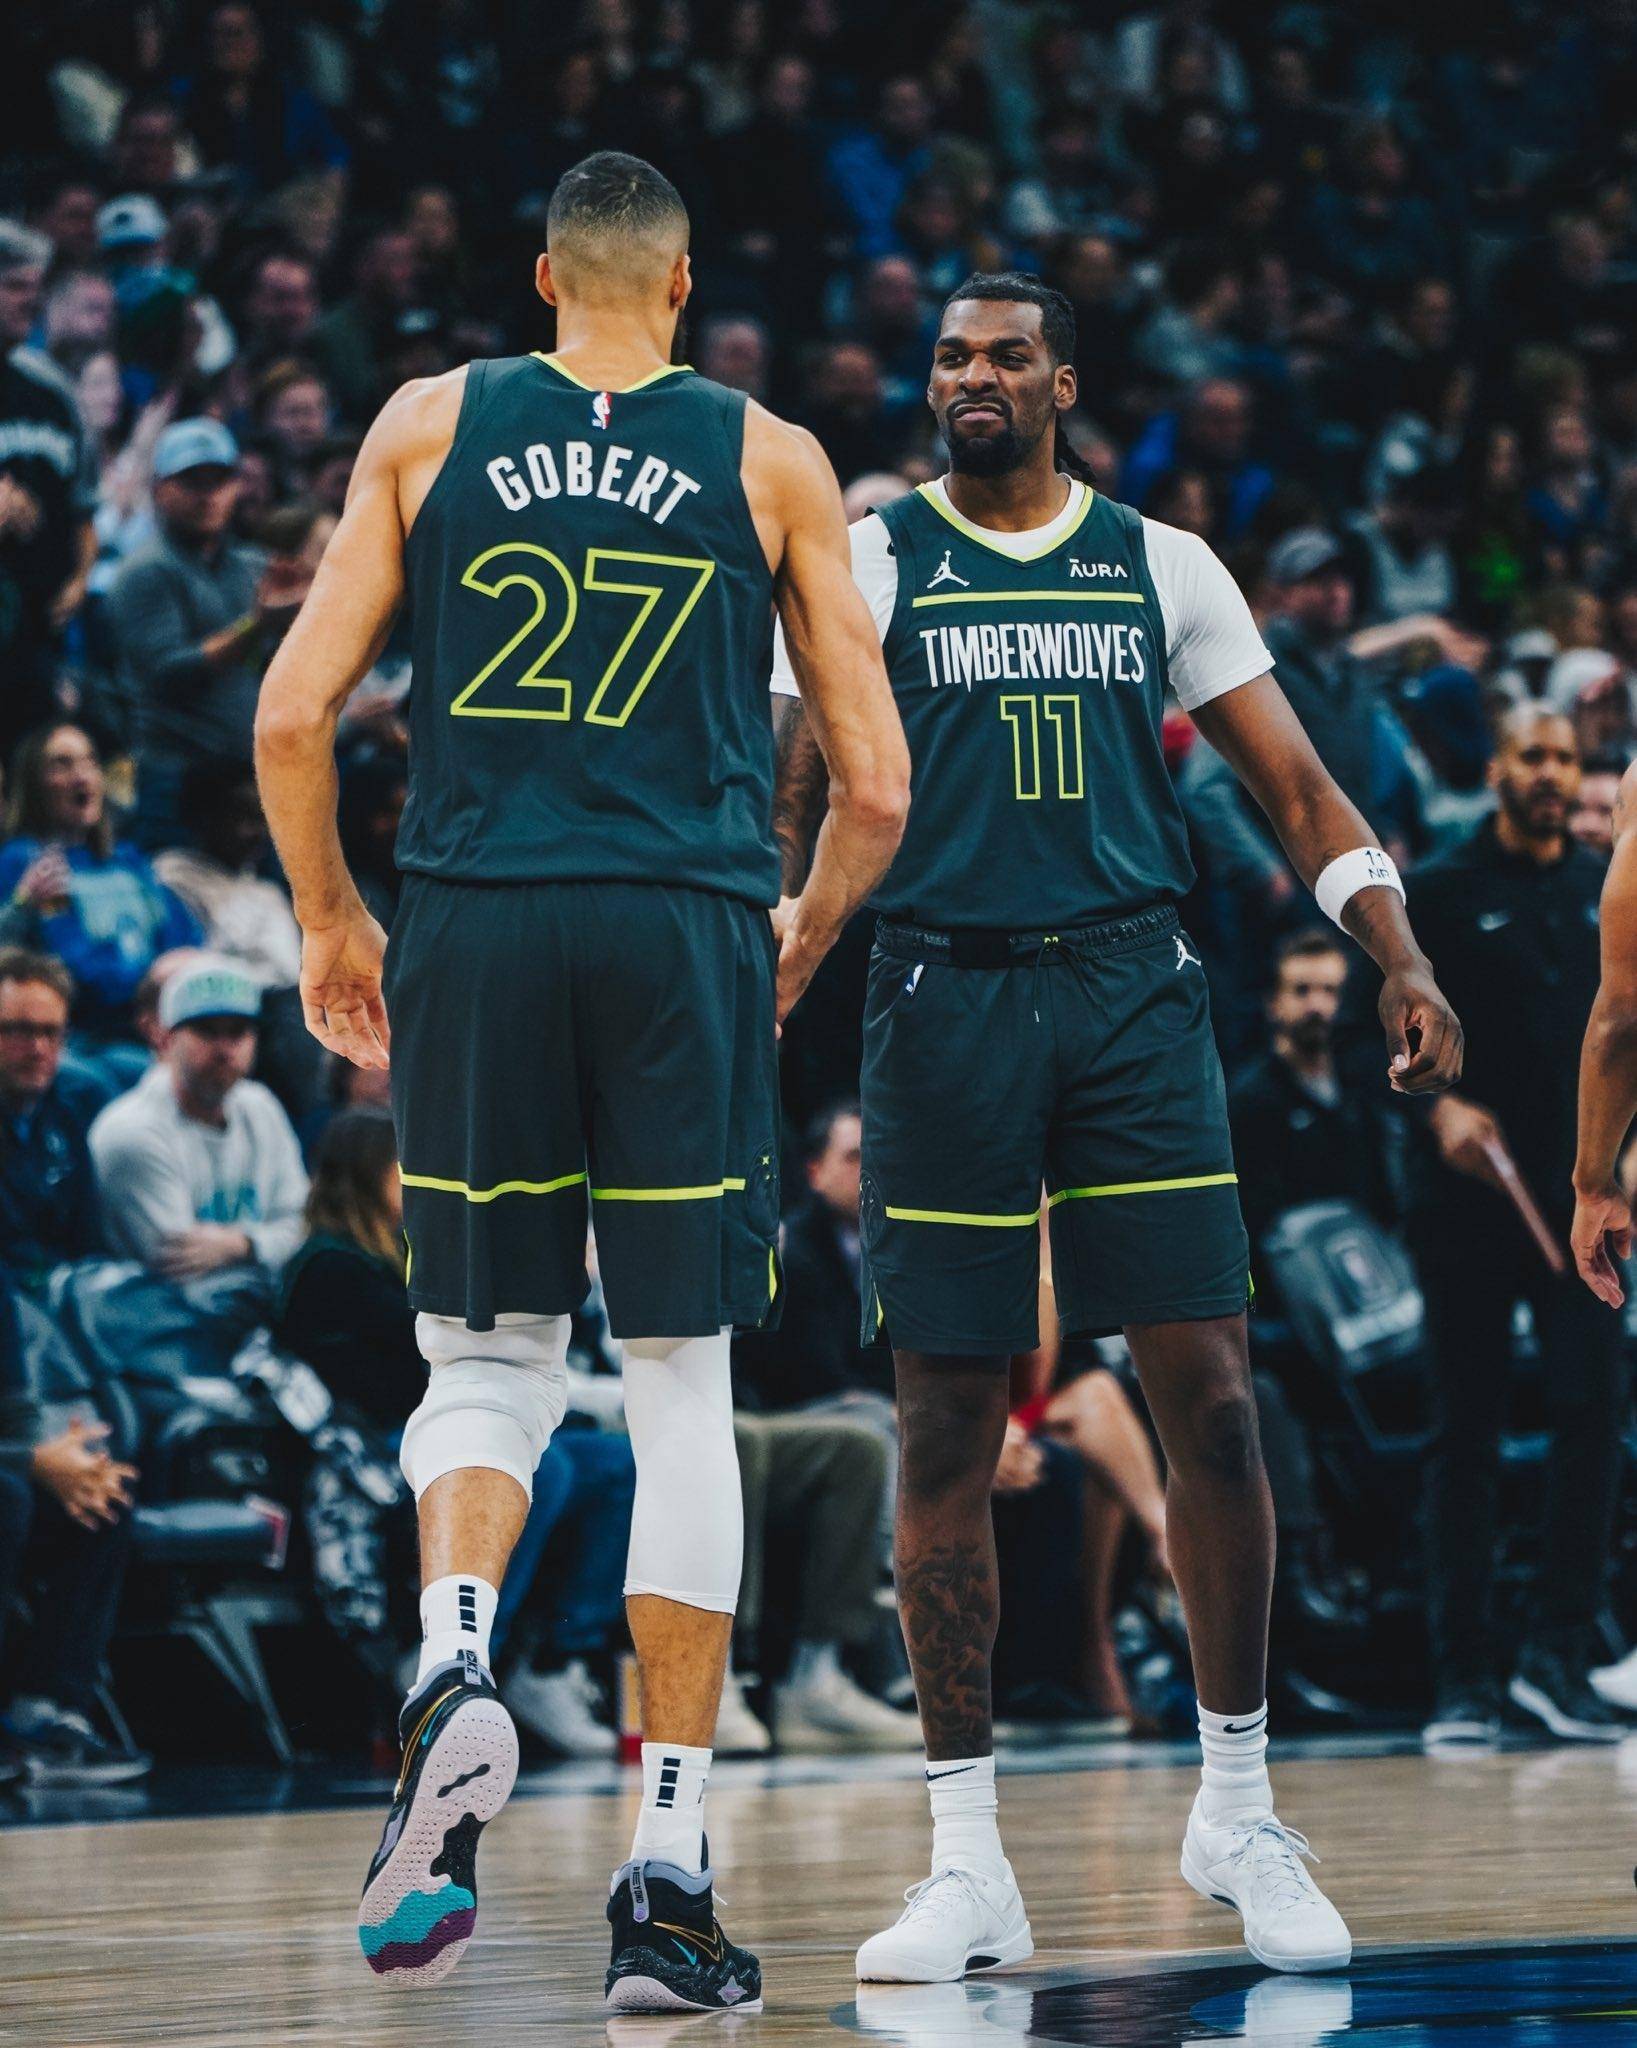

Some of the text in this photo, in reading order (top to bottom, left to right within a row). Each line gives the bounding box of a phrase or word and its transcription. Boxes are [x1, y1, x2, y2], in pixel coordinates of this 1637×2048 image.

[486, 441, 702, 525] GOBERT
[450, 542, 715, 727] 27
[919, 622, 1145, 693] TIMBERWOLVES
[1000, 694, 1084, 800] 11
[1365, 850, 1385, 866] 11
